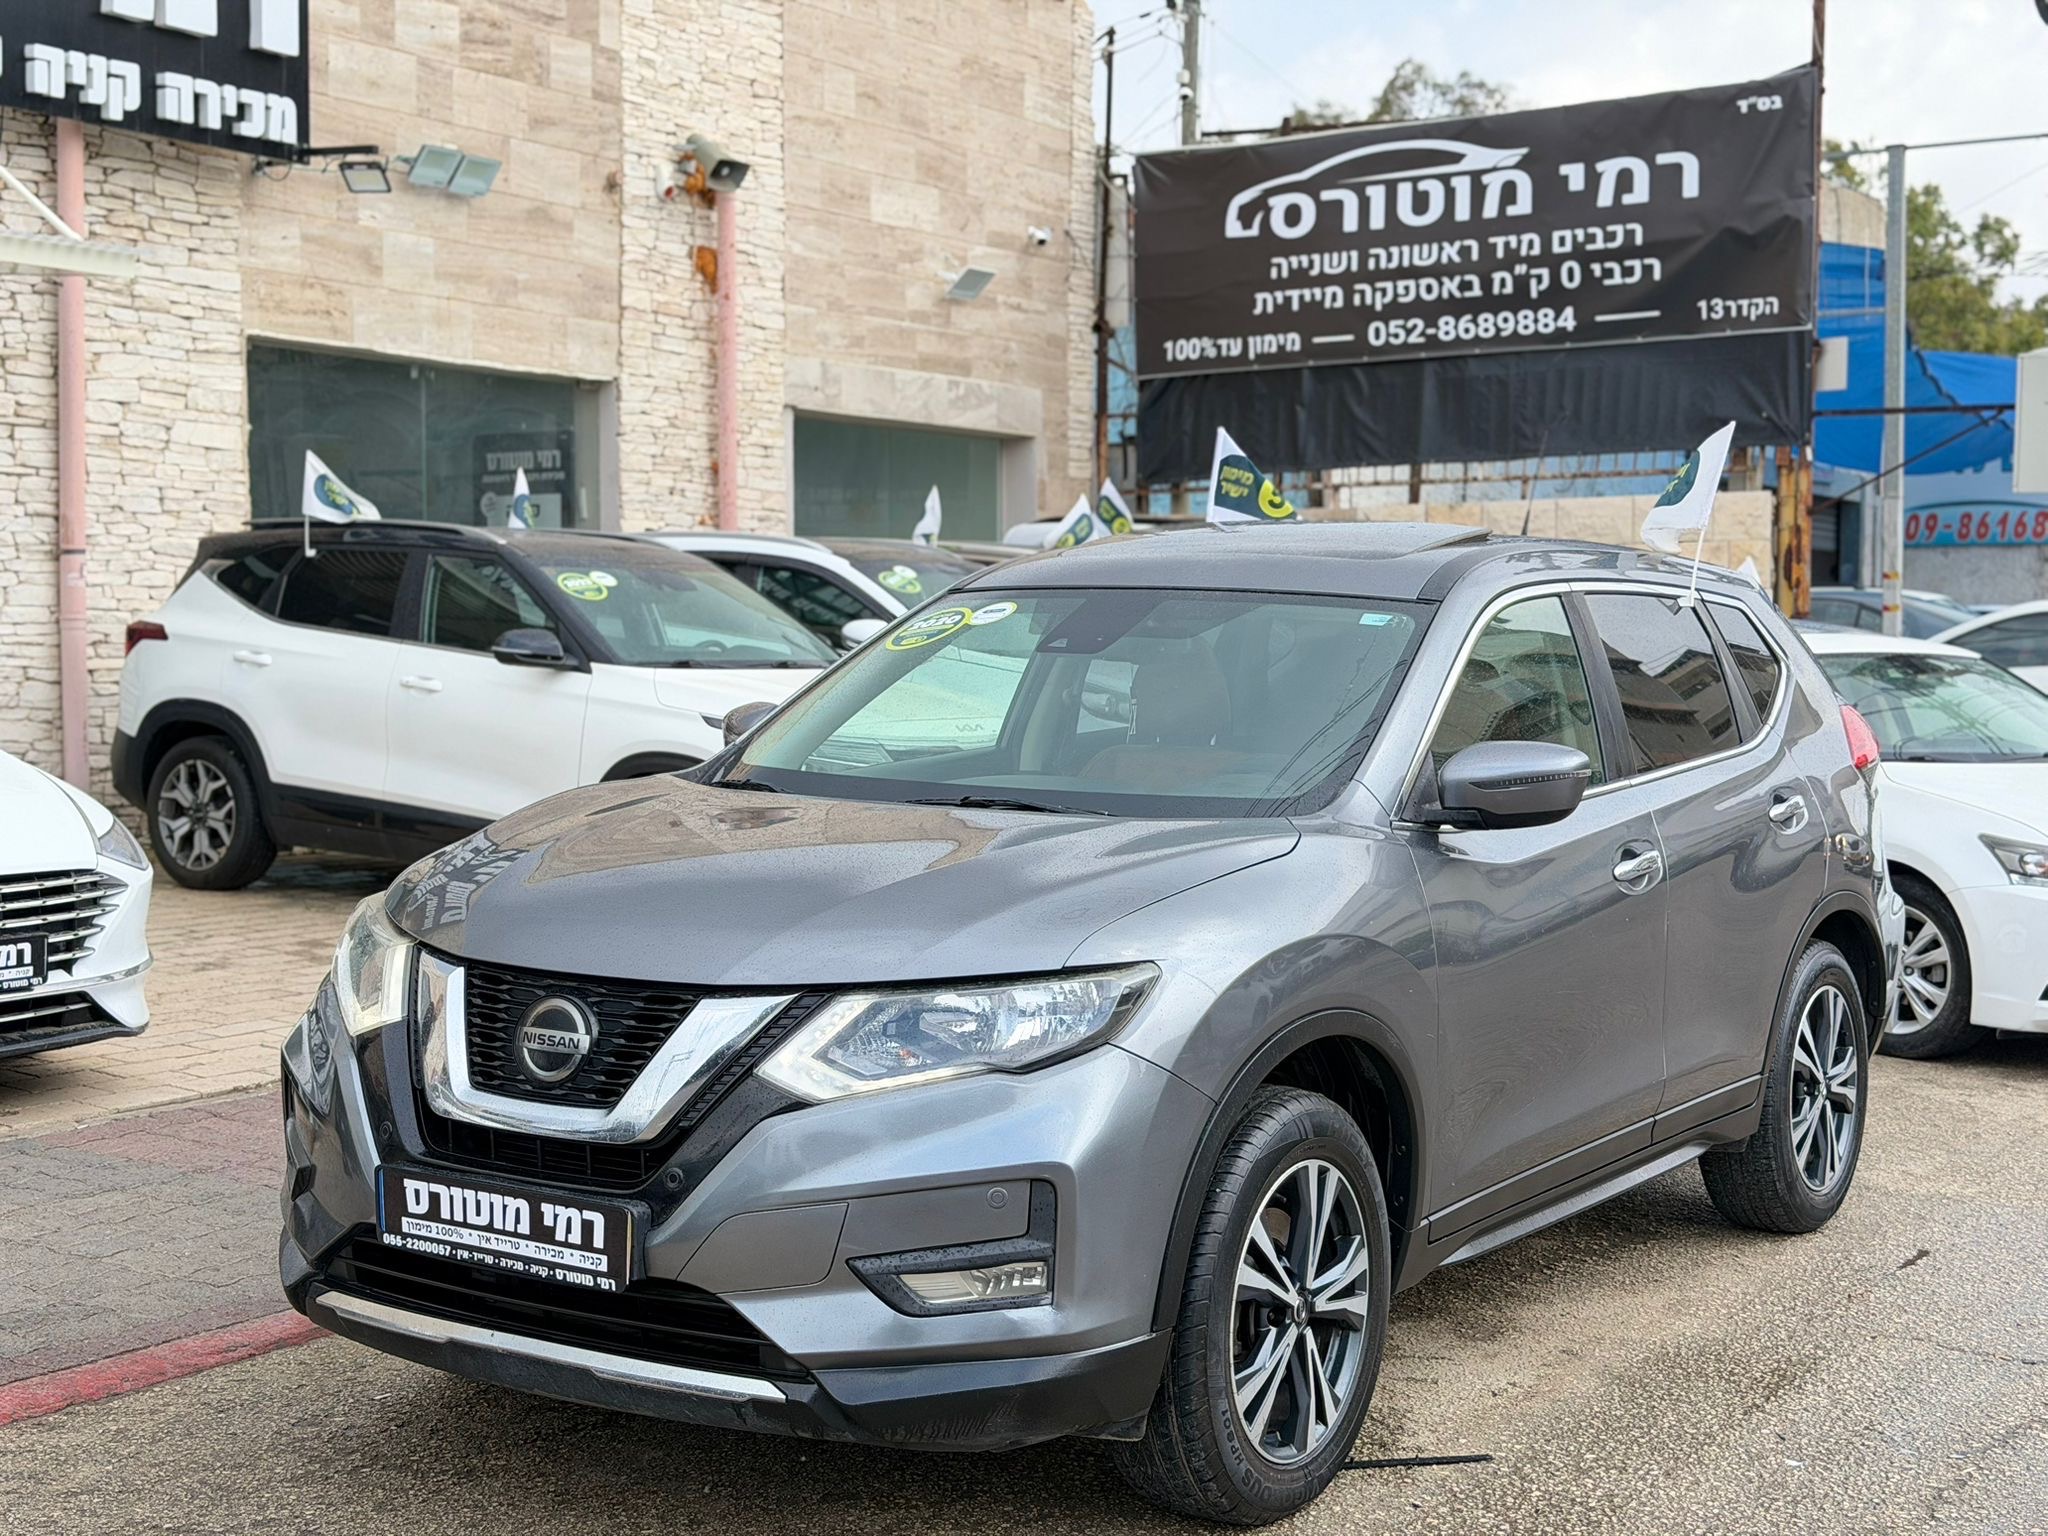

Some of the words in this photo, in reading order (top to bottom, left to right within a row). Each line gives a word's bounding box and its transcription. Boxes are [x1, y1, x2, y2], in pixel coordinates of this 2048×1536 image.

[24, 43, 141, 121] קניה
[156, 71, 298, 145] מכירה
[1558, 151, 1700, 208] רמי
[1267, 168, 1533, 239] מוטורס
[1488, 232, 1541, 259] מיד
[1552, 222, 1643, 254] רכבים
[1270, 250, 1358, 280] ושנייה
[1368, 239, 1479, 271] ראשונה
[1560, 260, 1582, 289] 0
[1590, 257, 1662, 286] רכבי
[1253, 285, 1344, 316] מיידית
[1352, 273, 1482, 311] באספקה
[1368, 306, 1577, 347] 052-8689884
[1247, 332, 1301, 360] מימון
[522, 1031, 580, 1050] NISSAN
[403, 1178, 530, 1235] מוטורס
[406, 1220, 432, 1235] מימון
[435, 1225, 464, 1240] 100%
[540, 1202, 605, 1249] רמי
[383, 1233, 451, 1257] 055-2200057
[494, 1236, 520, 1250] טרייד
[534, 1245, 565, 1260] מכירה
[500, 1257, 524, 1271] מכירה
[530, 1264, 548, 1278] קניה
[578, 1253, 602, 1269] קניה
[555, 1269, 594, 1286] מוטורס
[597, 1276, 616, 1291] רמי
